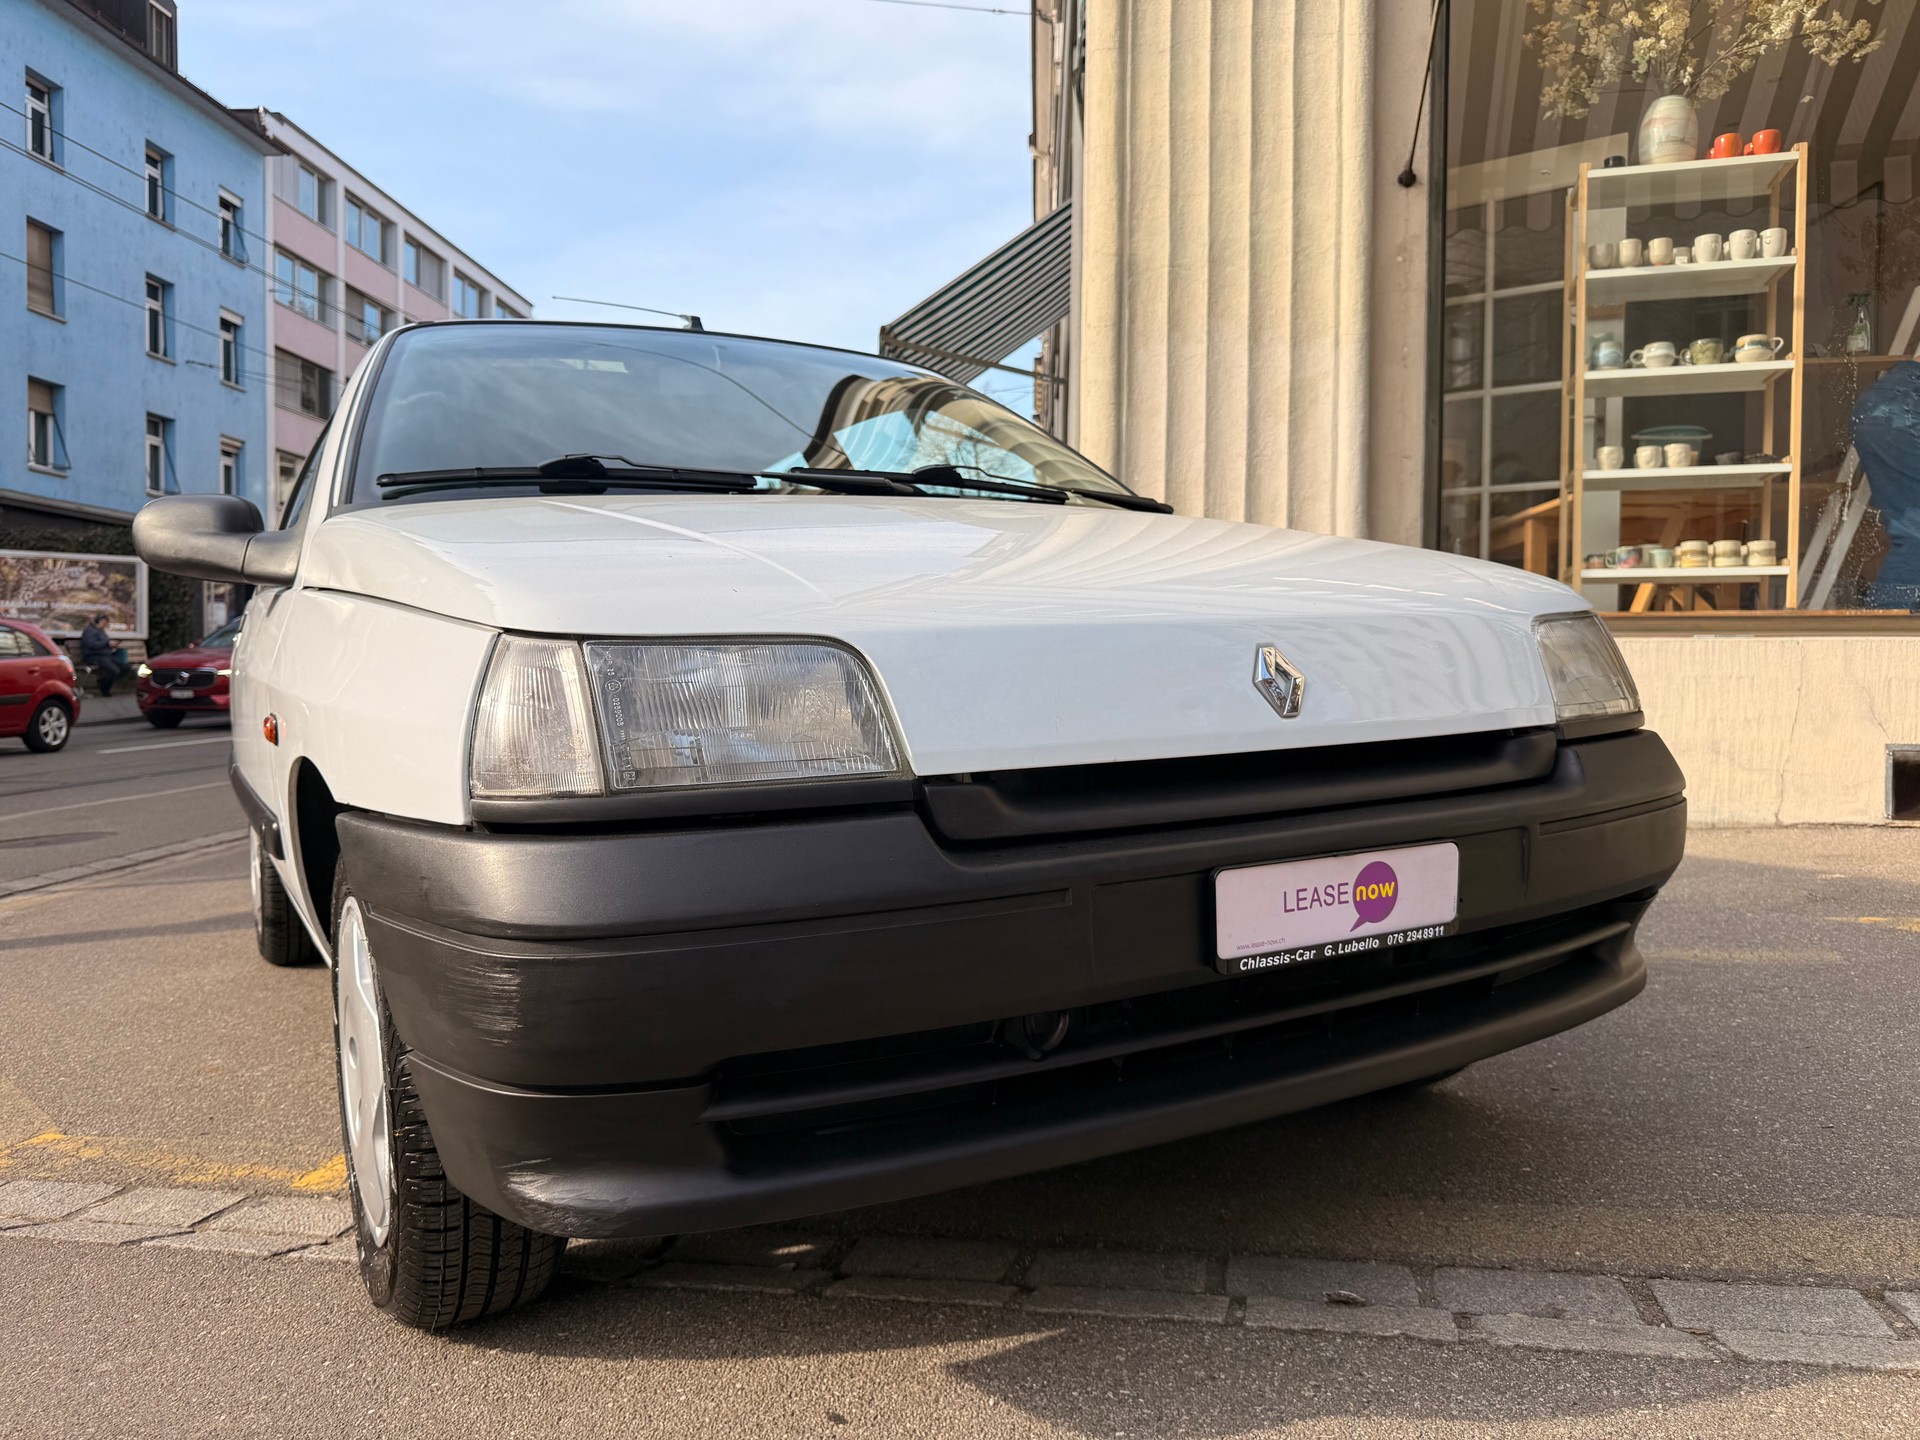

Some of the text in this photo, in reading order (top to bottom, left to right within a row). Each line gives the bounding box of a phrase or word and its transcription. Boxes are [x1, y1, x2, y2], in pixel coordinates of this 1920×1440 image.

[1283, 881, 1395, 913] LEASE now
[1236, 937, 1286, 951] www.lease-now.ch
[1240, 925, 1444, 971] Chlassis-Car G. Lubello 076 2948911
